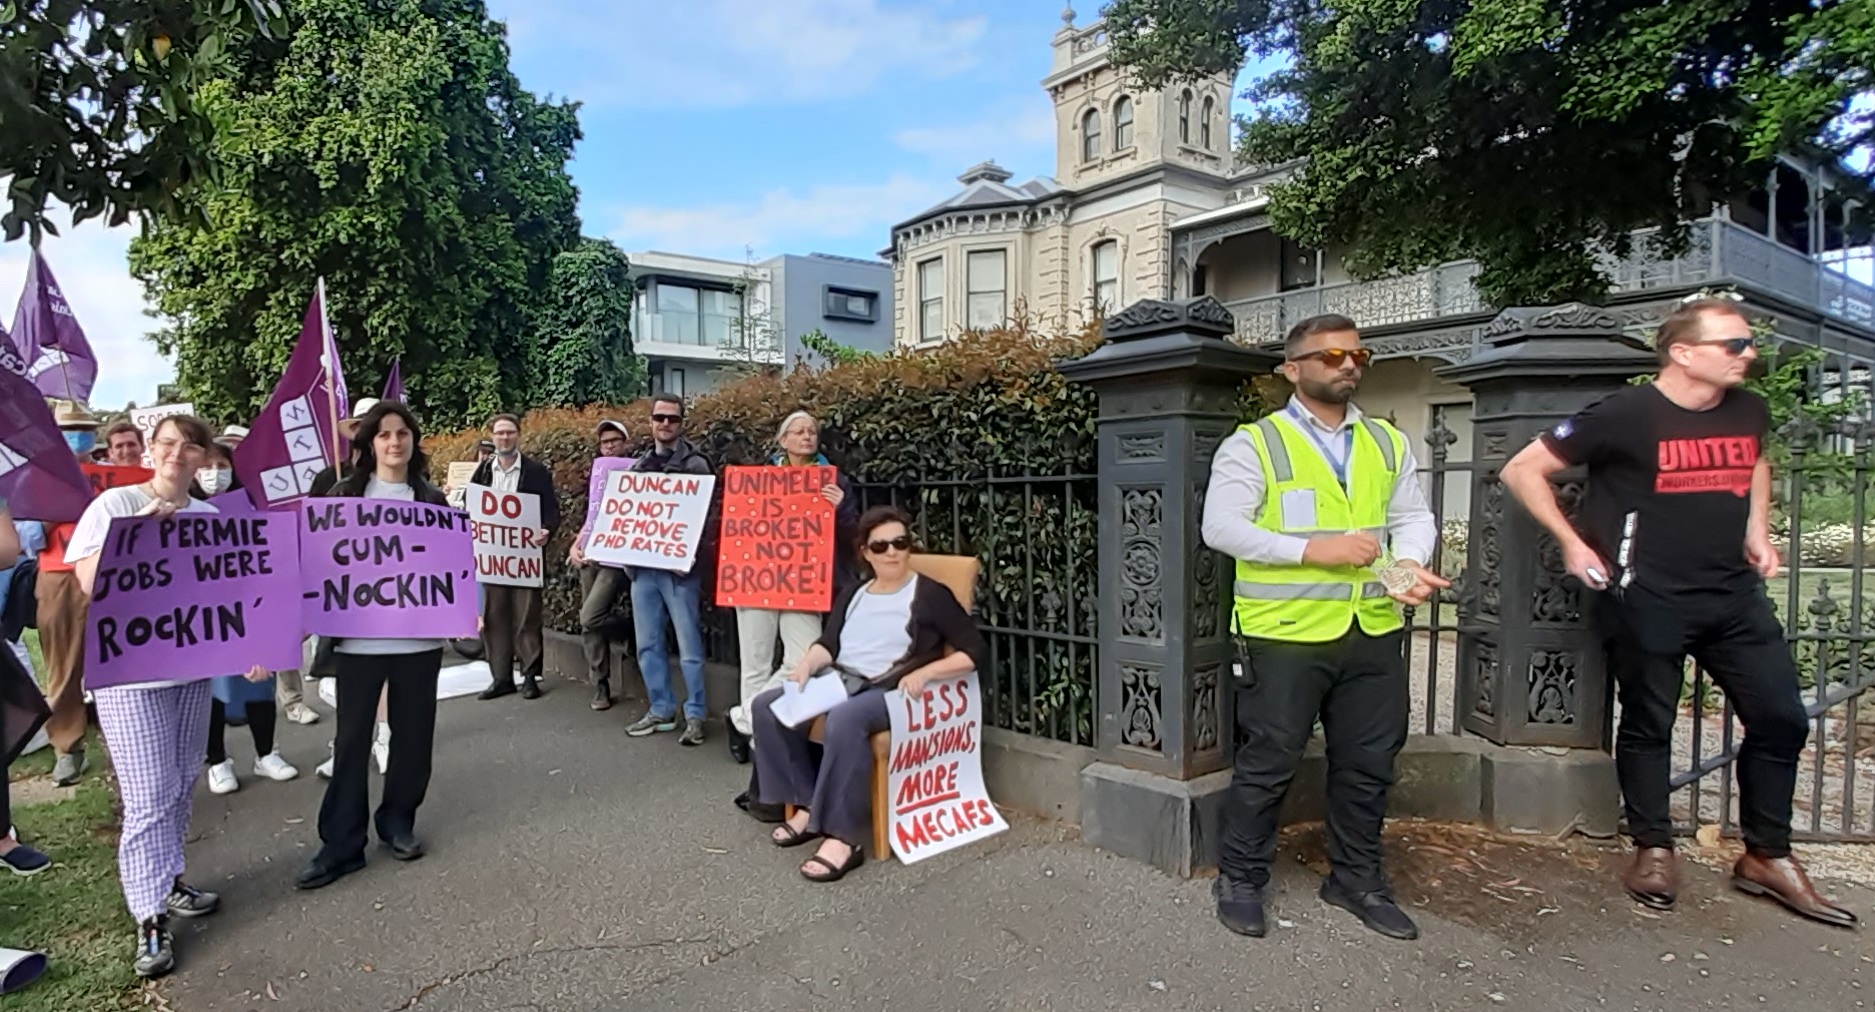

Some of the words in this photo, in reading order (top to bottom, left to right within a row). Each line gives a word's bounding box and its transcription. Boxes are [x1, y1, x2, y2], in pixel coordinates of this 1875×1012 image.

[1658, 437, 1758, 471] UNITED
[618, 475, 700, 496] DUNCAN
[306, 503, 347, 532] WE
[356, 503, 470, 532] WOULDN'T
[481, 490, 522, 519] DO
[605, 499, 634, 516] DO
[636, 501, 680, 520] NOT
[761, 498, 783, 518] IS
[116, 523, 143, 556] IF
[159, 518, 268, 549] PERMIE
[611, 518, 688, 541] REMOVE
[725, 514, 822, 540] BROKEN
[592, 533, 627, 549] PHD
[630, 537, 688, 558] RATES
[755, 541, 814, 563] NOT
[93, 558, 172, 602] JOBS
[193, 550, 273, 582] WERE
[720, 562, 826, 595] BROKE!
[97, 597, 263, 664] ROCKIN'
[905, 679, 969, 733] LESS
[889, 720, 976, 775] MANSIONS,
[896, 761, 959, 806] MORE
[896, 799, 994, 854] MECAFS
